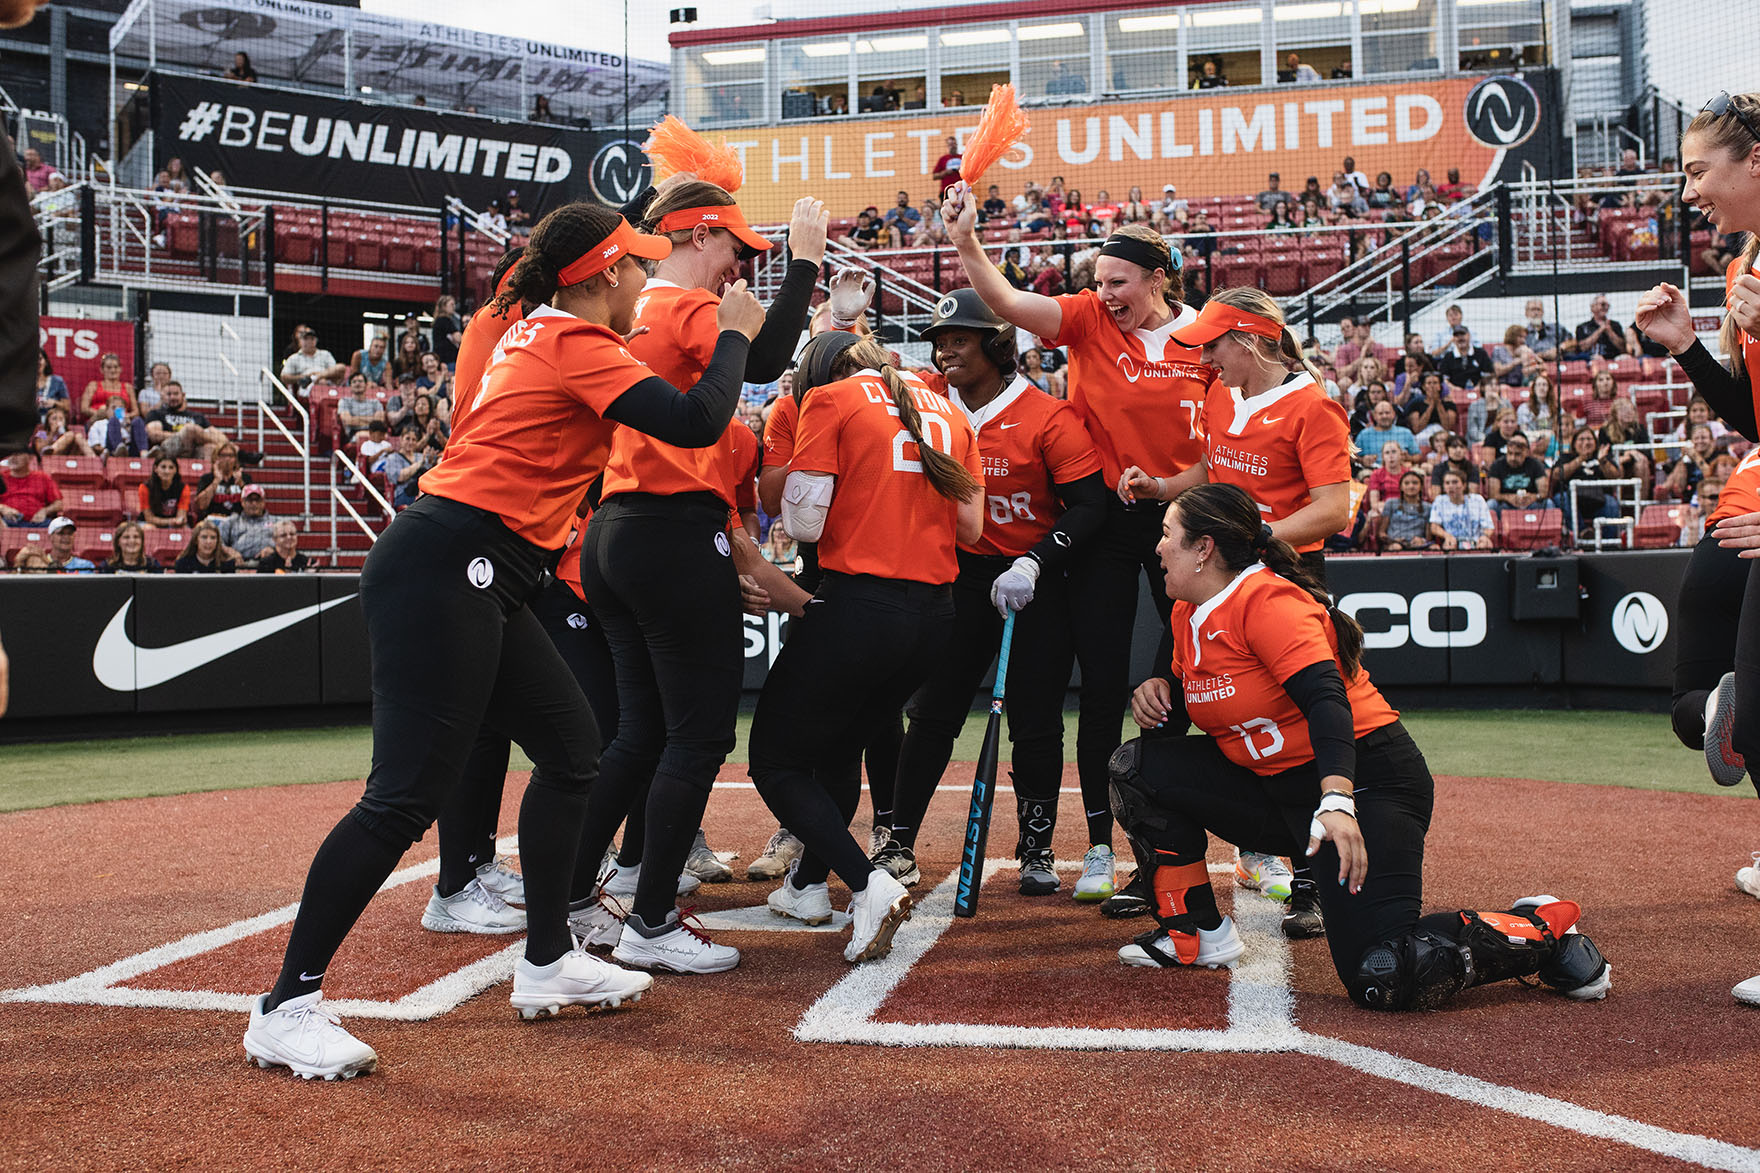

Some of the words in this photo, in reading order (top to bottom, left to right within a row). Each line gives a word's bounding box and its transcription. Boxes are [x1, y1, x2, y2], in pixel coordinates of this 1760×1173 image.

[420, 24, 521, 51] ATHLETES
[527, 42, 622, 68] UNLIMITED
[179, 101, 572, 184] #BEUNLIMITED
[727, 126, 1035, 184] THLETS
[1056, 94, 1443, 165] UNLIMITED
[602, 244, 620, 259] 2022
[860, 382, 953, 415] CLTON
[1214, 455, 1268, 477] UNLIMITED
[1215, 445, 1269, 467] ATHLETES
[988, 491, 1037, 525] 88
[1335, 590, 1488, 649] CO
[1186, 673, 1233, 691] ATHLETES
[1186, 686, 1236, 704] UNLIMITED
[1229, 717, 1285, 761] 13
[956, 778, 987, 909] EASTON
